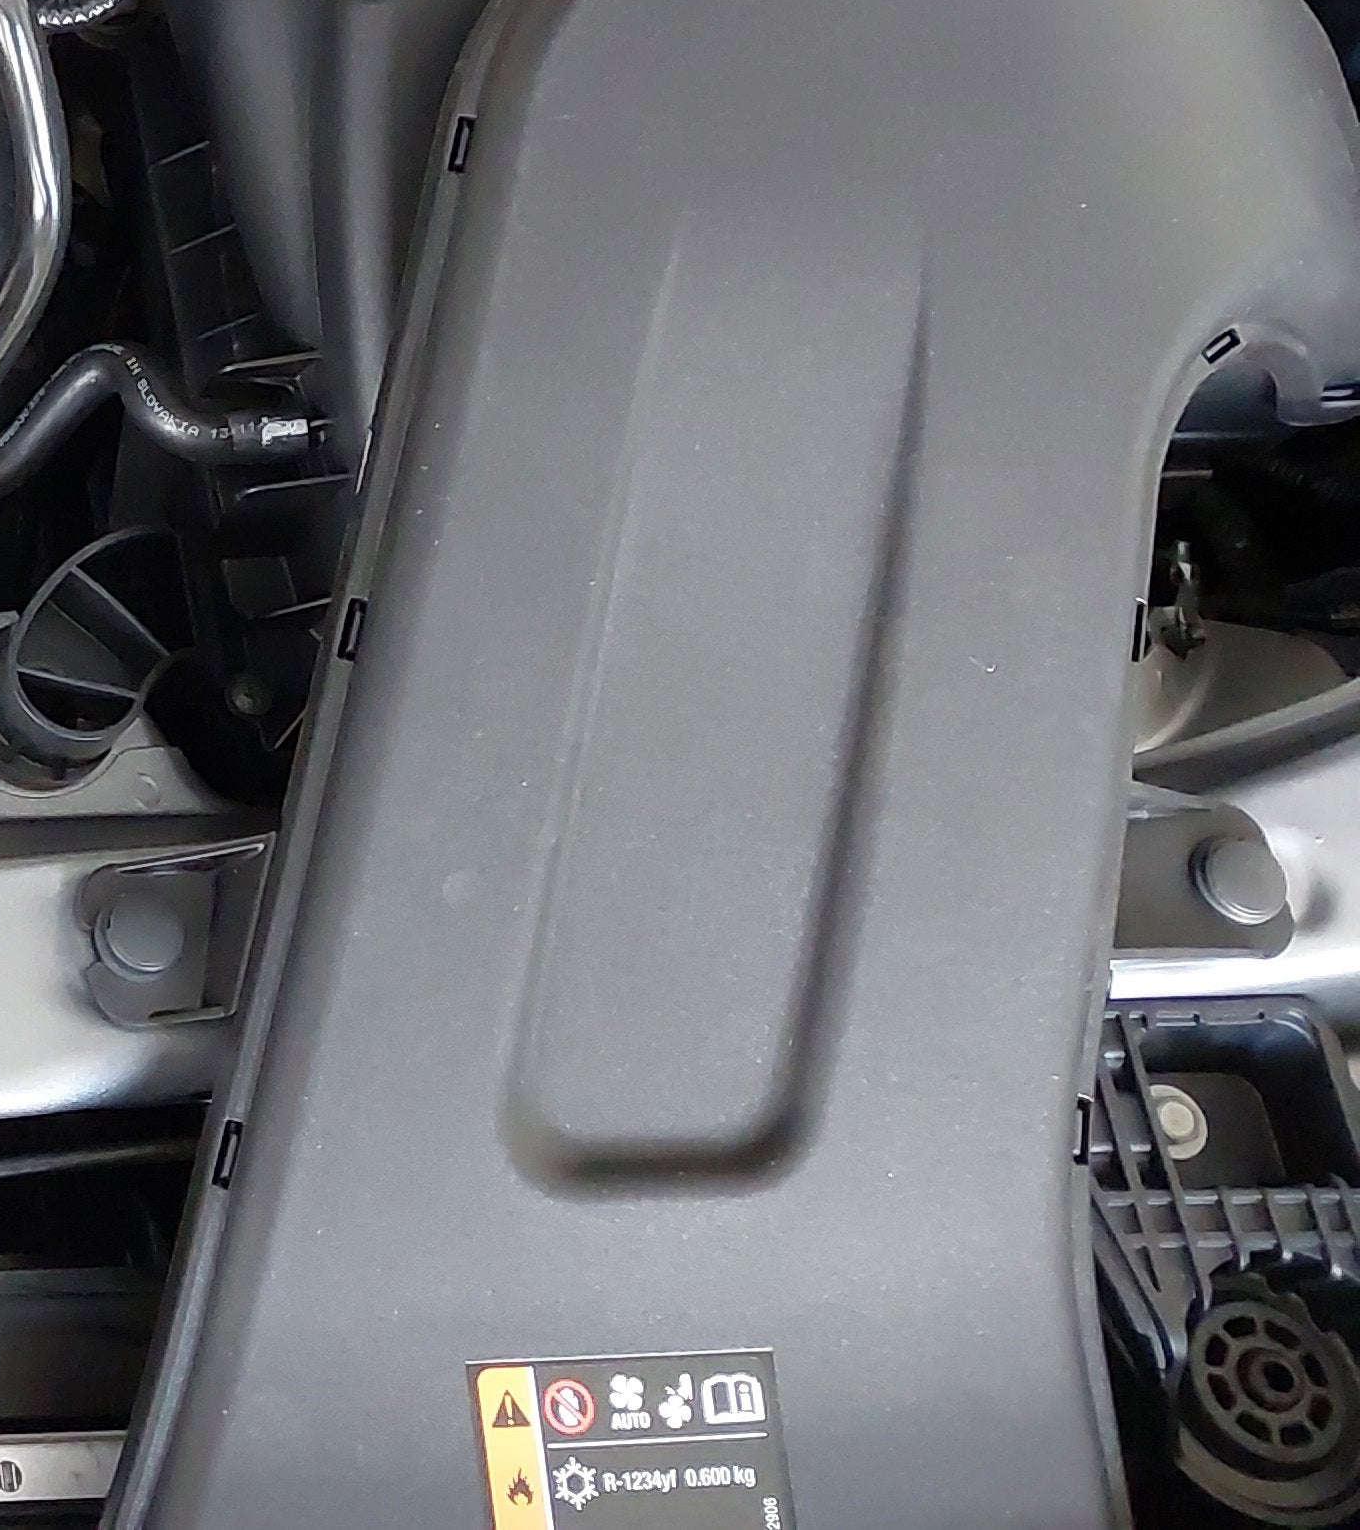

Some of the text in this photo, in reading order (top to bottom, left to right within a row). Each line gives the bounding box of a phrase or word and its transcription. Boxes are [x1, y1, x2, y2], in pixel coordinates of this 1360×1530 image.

[611, 1410, 652, 1431] AUTO
[602, 1464, 757, 1493] R-1234yf 0.600 kg
